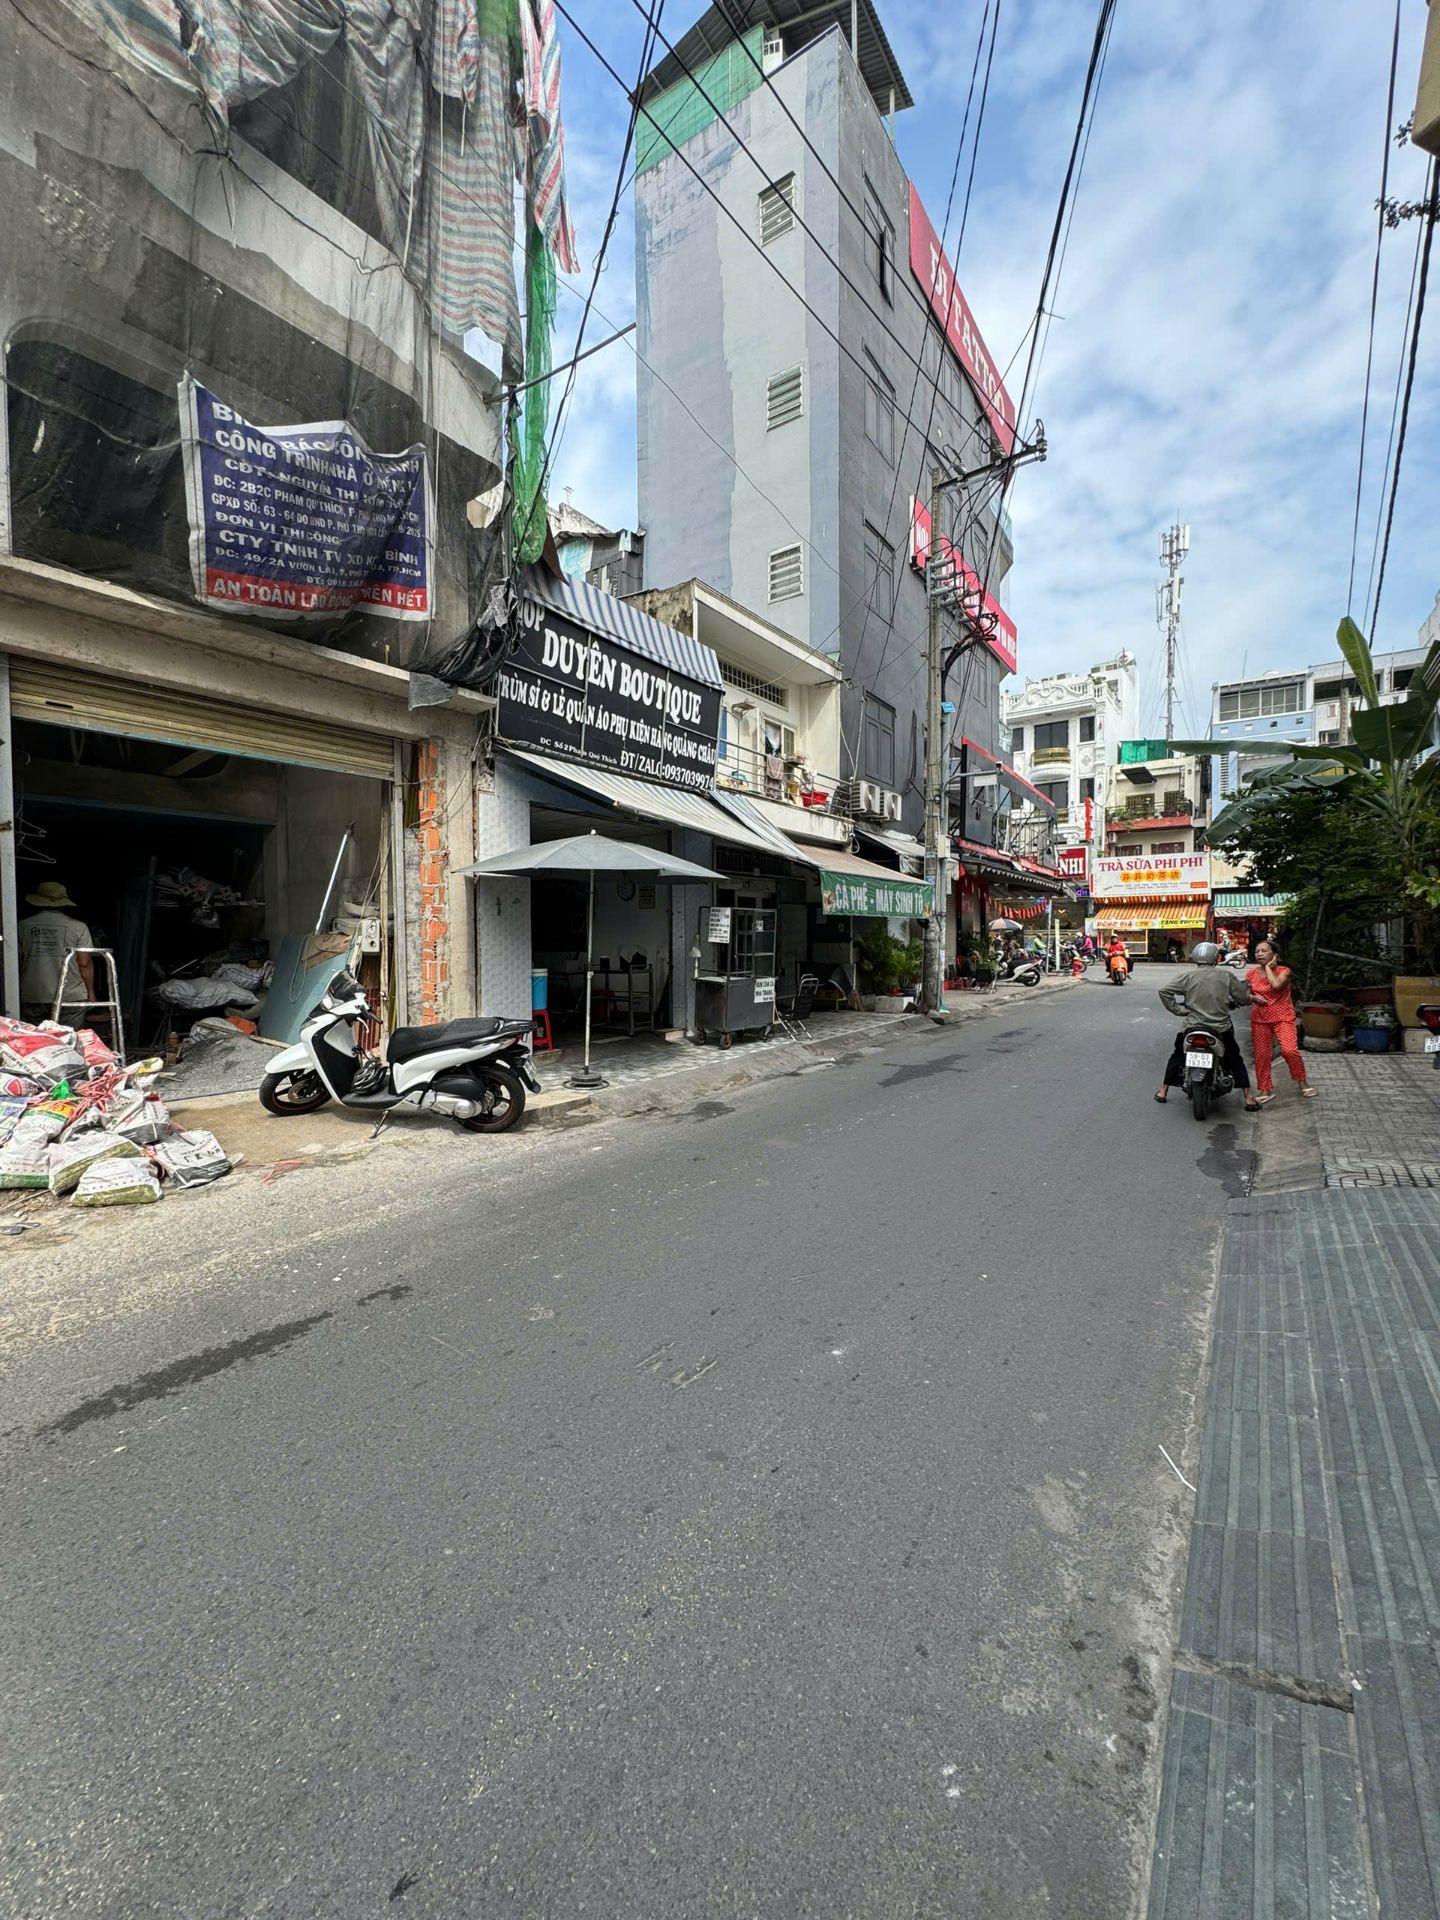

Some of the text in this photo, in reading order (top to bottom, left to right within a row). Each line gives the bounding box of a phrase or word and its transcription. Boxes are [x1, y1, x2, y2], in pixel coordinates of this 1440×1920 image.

[952, 292, 1005, 426] TATTOO
[215, 430, 277, 460] CÔNG
[239, 480, 272, 498] 2B2C
[215, 511, 254, 528] ĐƠN
[280, 526, 304, 539] THI
[263, 504, 276, 518] 63
[219, 529, 263, 549] CTY
[270, 539, 318, 559] TNHH
[384, 549, 419, 566] BÌNH
[213, 578, 240, 596] AN
[246, 583, 296, 605] TOÀN
[396, 589, 422, 608] HẾT
[541, 628, 702, 724] DUYÊN BOUTIQUE
[541, 690, 551, 712] &
[595, 704, 610, 732] ÁO
[629, 718, 652, 745] KIỆN
[1098, 856, 1204, 872] TRÀ SỮA PHI PHI
